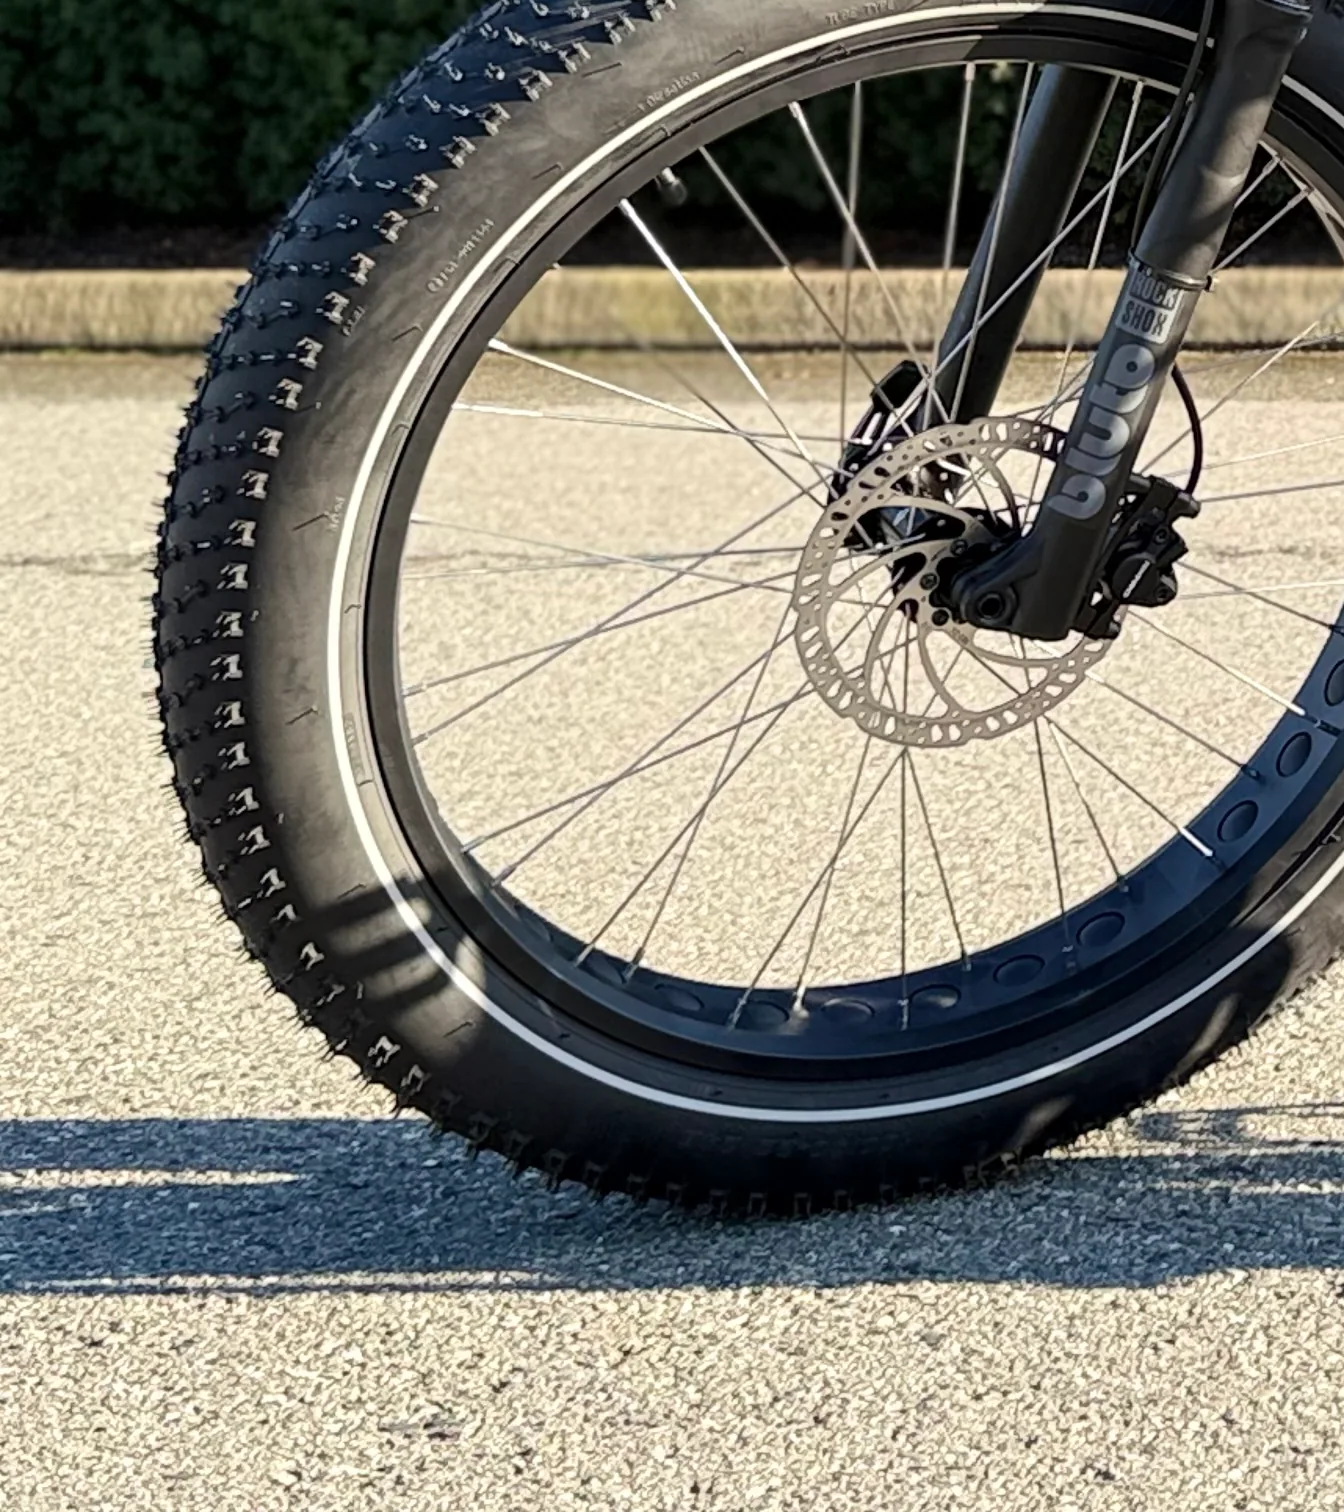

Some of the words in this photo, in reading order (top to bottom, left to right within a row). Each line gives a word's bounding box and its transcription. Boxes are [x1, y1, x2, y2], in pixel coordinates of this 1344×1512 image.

[1130, 269, 1180, 309] ROCK
[1121, 300, 1169, 337] SHOX
[1046, 343, 1156, 520] bluto
